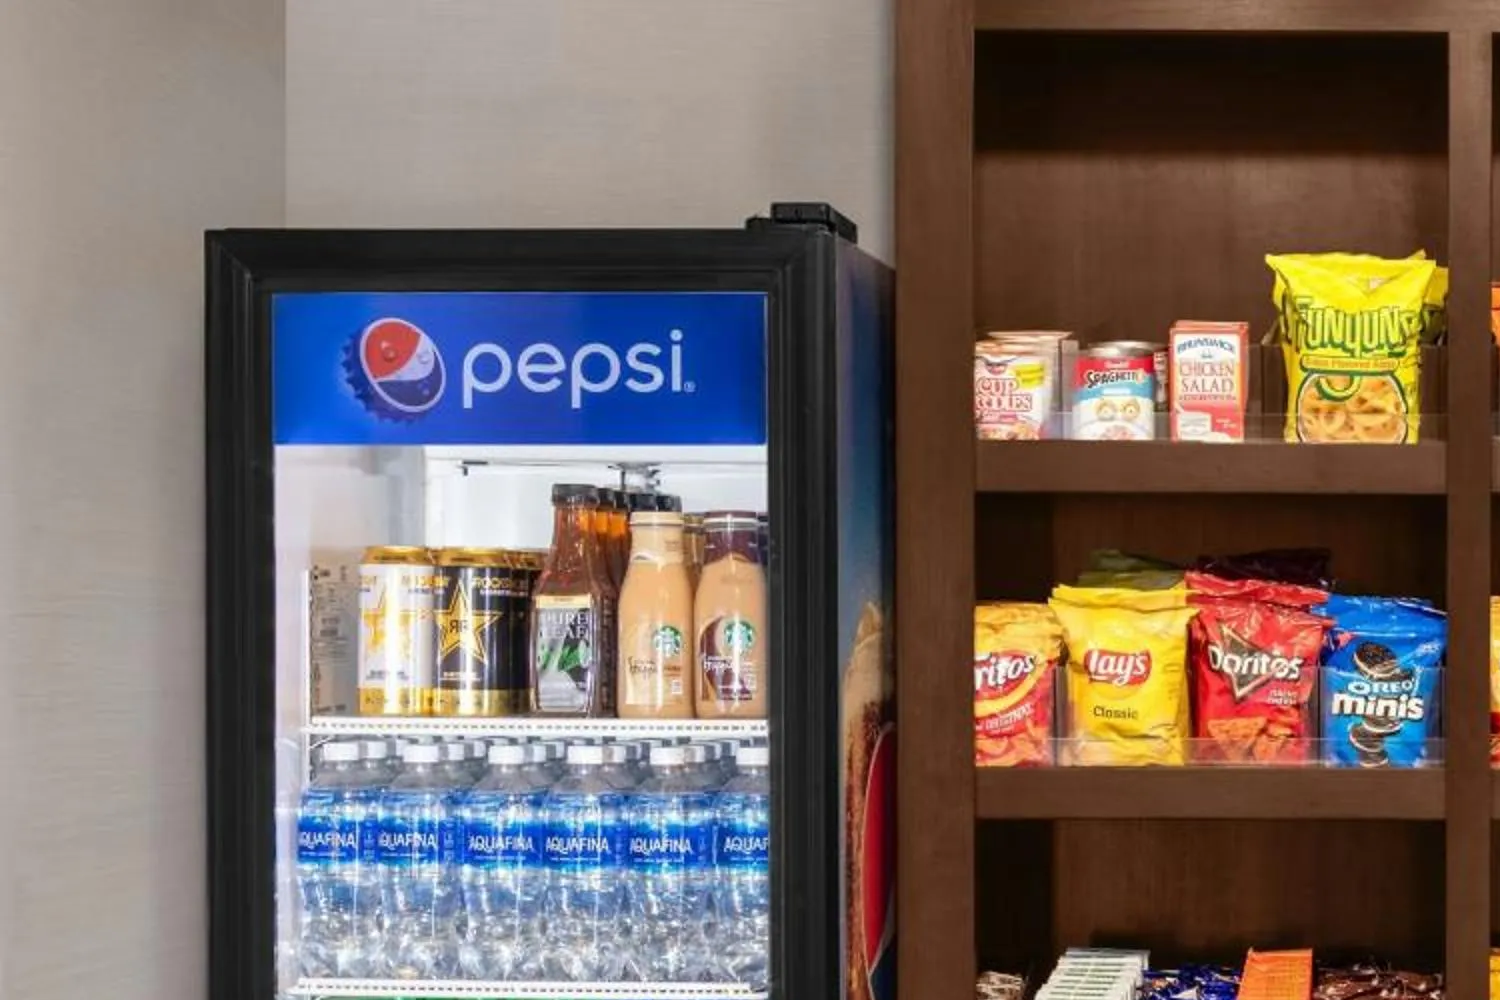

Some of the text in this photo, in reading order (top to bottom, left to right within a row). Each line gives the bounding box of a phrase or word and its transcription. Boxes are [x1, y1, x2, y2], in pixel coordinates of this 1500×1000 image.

[463, 329, 683, 409] pepsi
[1179, 361, 1234, 377] CHICKEN
[1181, 379, 1234, 393] SALAD
[1208, 644, 1303, 680] Doritos
[975, 654, 1036, 689] ritos
[1347, 680, 1413, 694] OREO
[1093, 705, 1138, 720] Classic
[1331, 693, 1425, 720] minis
[545, 836, 610, 854] AQUAFINA
[629, 837, 692, 855] AQUAFINA
